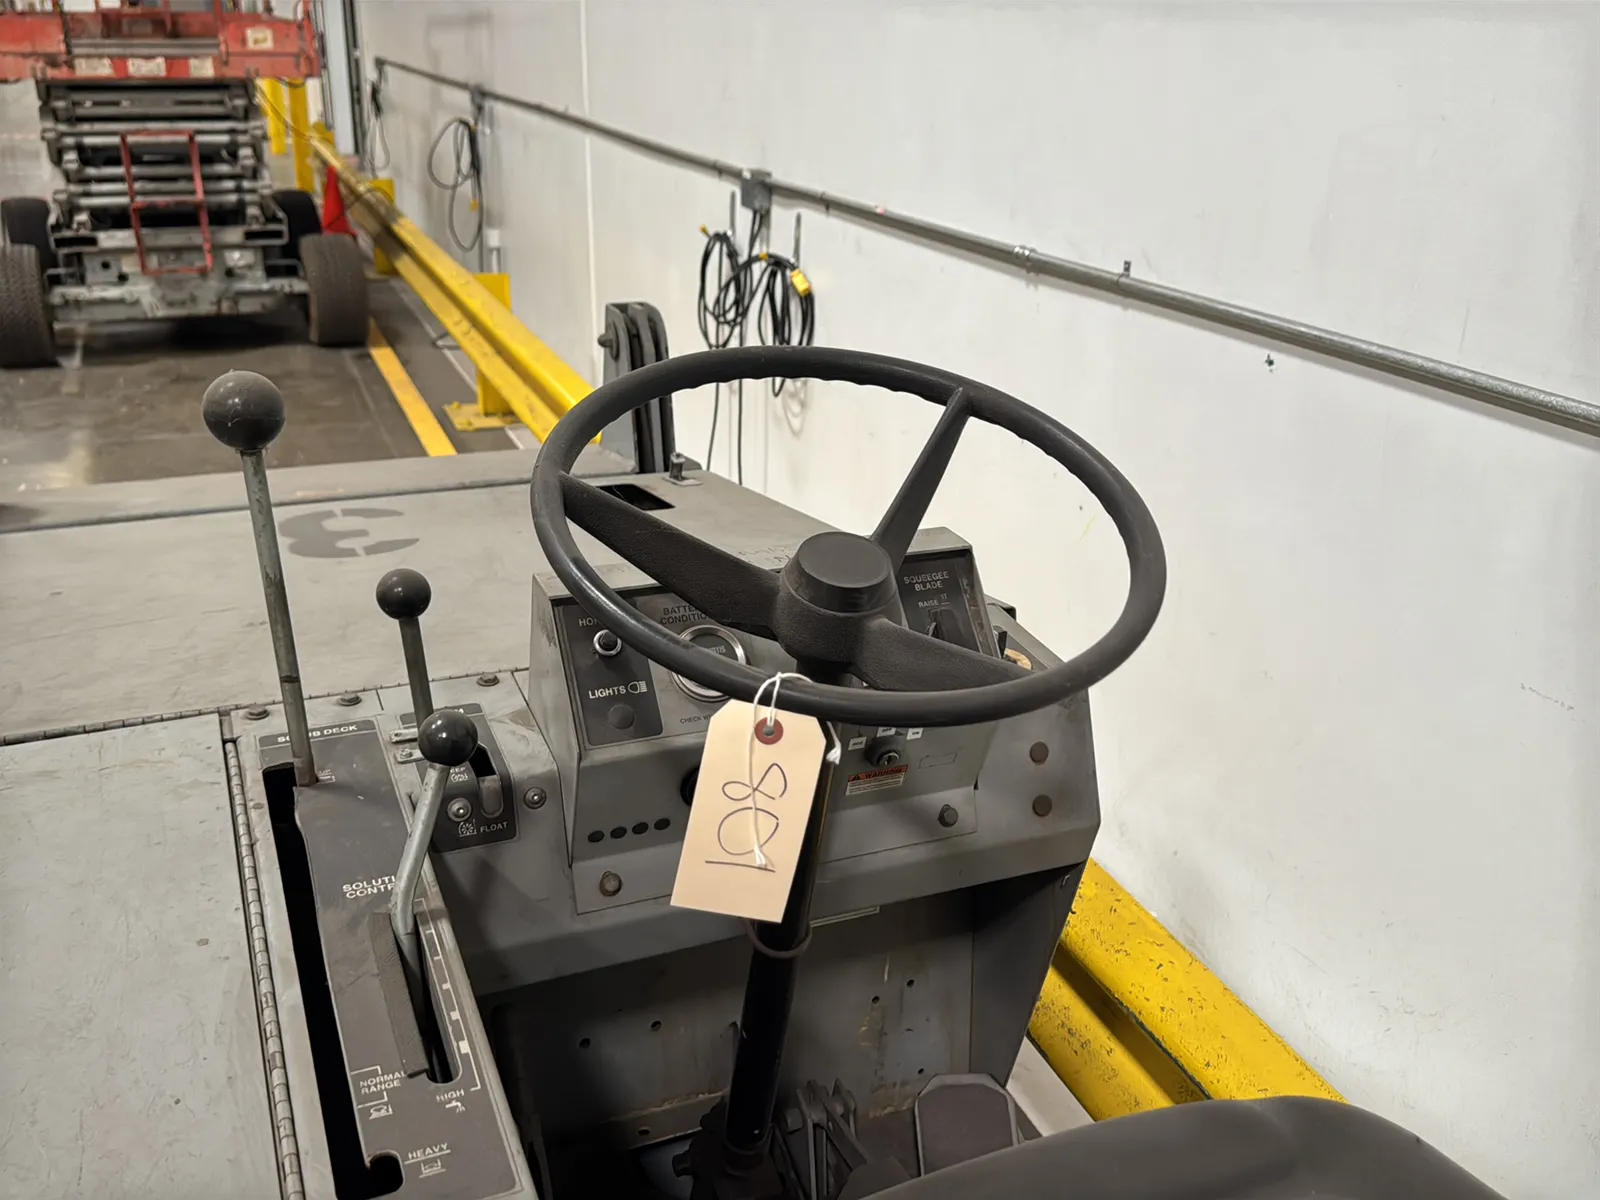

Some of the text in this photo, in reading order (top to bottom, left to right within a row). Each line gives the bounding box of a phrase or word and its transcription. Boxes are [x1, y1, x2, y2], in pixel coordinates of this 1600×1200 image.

[903, 570, 950, 585] SQUEEGEE
[914, 580, 944, 592] BLADE
[662, 605, 698, 616] BATTE
[918, 599, 940, 609] RAISE
[660, 613, 709, 626] CONDITIO
[588, 685, 627, 699] LIGHTS
[323, 724, 358, 735] DECK
[480, 821, 509, 833] FLOAT
[342, 875, 396, 893] SOLUTI
[359, 1070, 407, 1088] NORMAL
[360, 1079, 402, 1096] RANGE
[436, 1088, 465, 1103] HIGH
[407, 1142, 449, 1160] HEAVY
